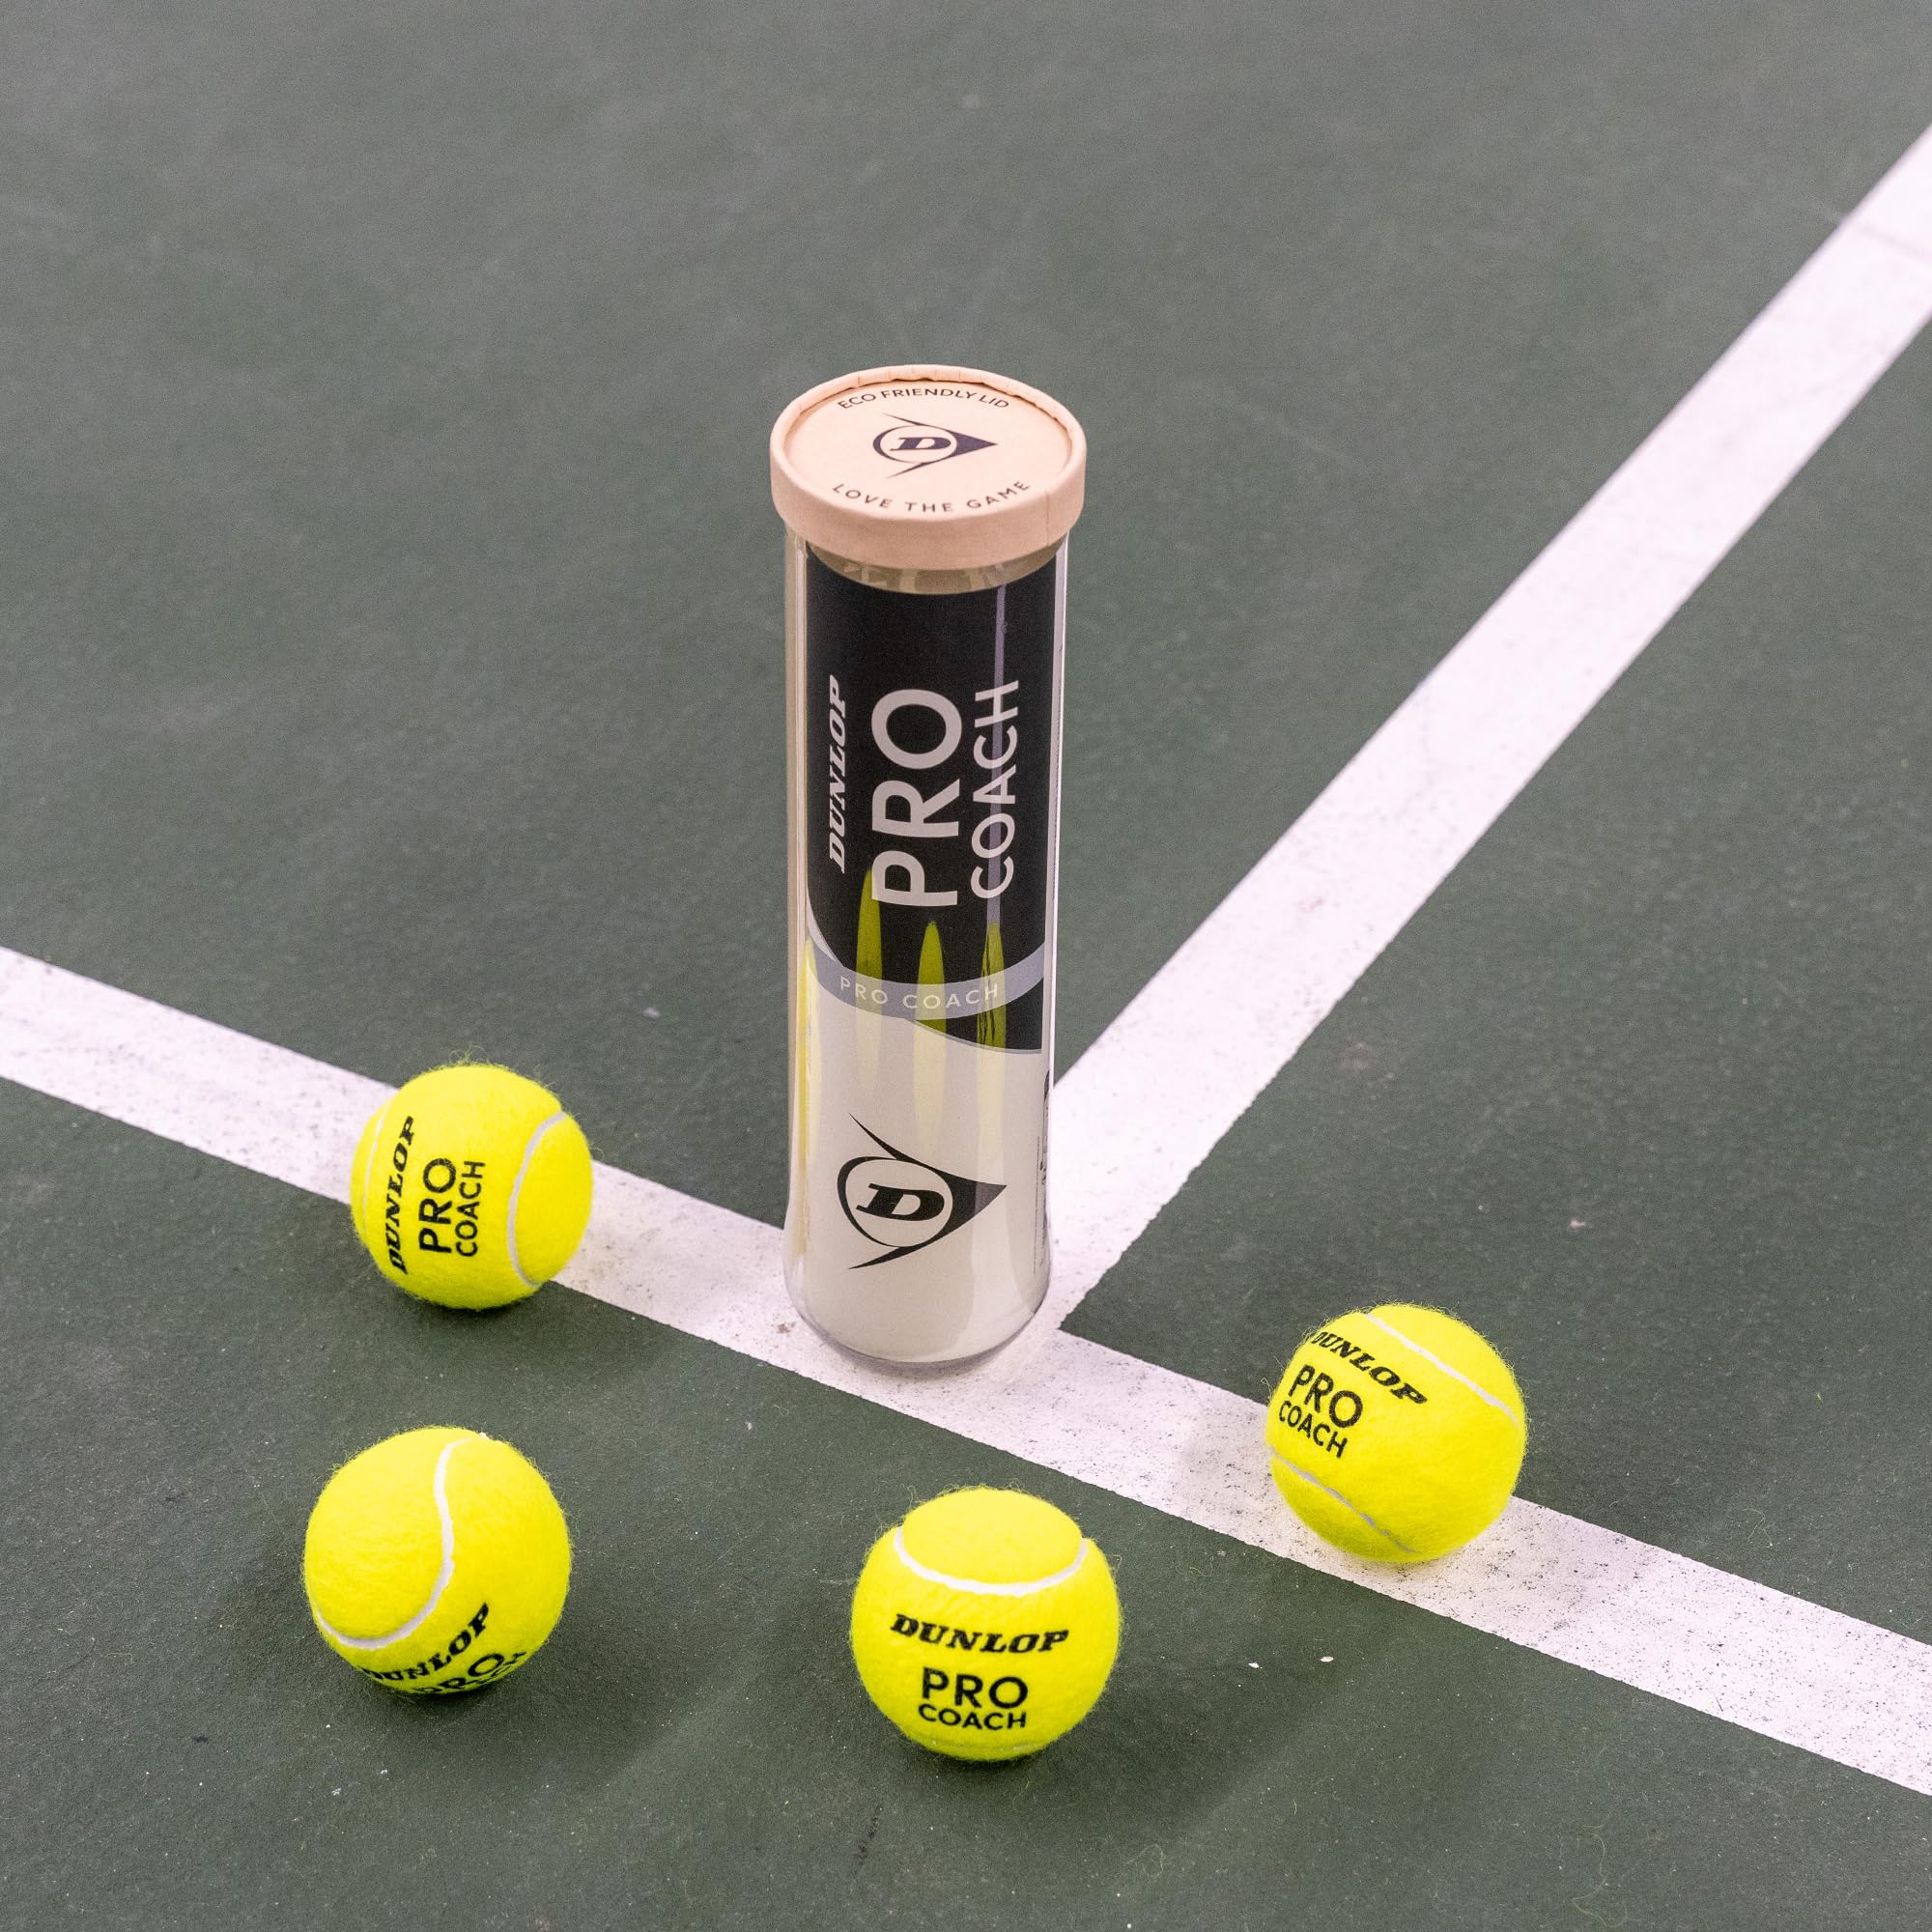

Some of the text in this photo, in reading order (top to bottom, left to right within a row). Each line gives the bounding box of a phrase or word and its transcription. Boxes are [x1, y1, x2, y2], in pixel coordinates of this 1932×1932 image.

[838, 387, 1009, 411] ECO FRIENDLY LID
[889, 437, 952, 452] D
[832, 479, 1030, 513] LOVE THE GAME
[829, 674, 846, 874] DUNLOP
[871, 689, 962, 907] PRO
[970, 679, 1019, 899] COACH
[839, 976, 998, 1009] PRO COACH
[384, 1116, 414, 1275] DUNLOP
[418, 1157, 457, 1254] PRO
[454, 1160, 486, 1258] COACH
[855, 1182, 946, 1222] D
[1288, 1363, 1364, 1429] PRO
[1311, 1331, 1428, 1405] DUNLOP
[1278, 1400, 1349, 1459] COACH
[890, 1613, 1069, 1654] DUNLOP
[918, 1703, 1028, 1731] COACH
[922, 1666, 1029, 1710] PRO
